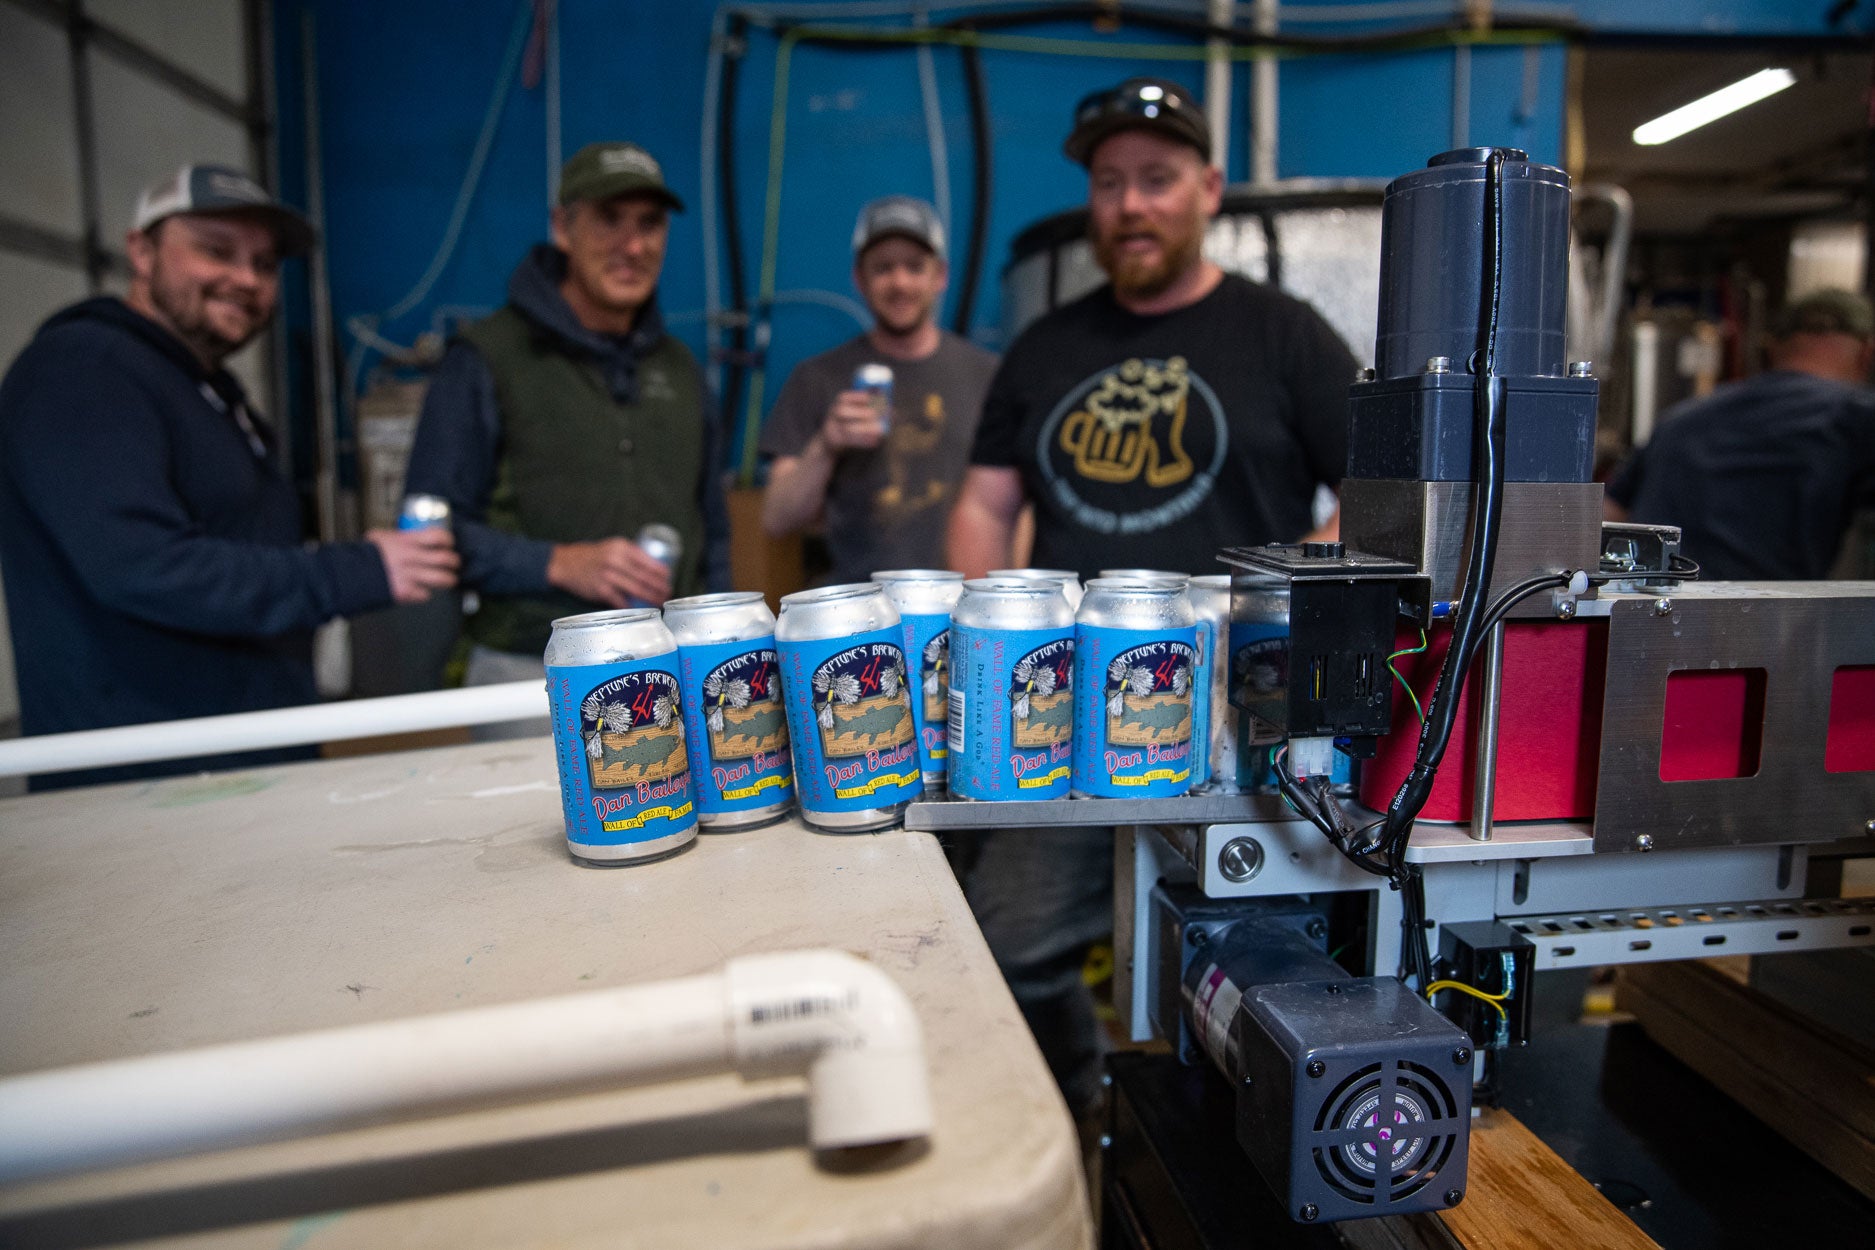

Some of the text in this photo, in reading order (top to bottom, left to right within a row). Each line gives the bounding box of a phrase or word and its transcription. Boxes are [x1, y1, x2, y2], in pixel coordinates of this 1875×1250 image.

[817, 646, 867, 678] NEPTUNE'S
[1021, 640, 1065, 669] NEPTUNE'S
[1092, 638, 1101, 672] WALL
[1115, 642, 1167, 665] NEPTUNE'S
[709, 652, 758, 682] NEPTUNE'S
[793, 652, 804, 686] WALL
[587, 674, 640, 706] NEPTUNE'S
[976, 663, 985, 696] DRINK
[1091, 675, 1099, 692] OF
[798, 690, 808, 707] OF
[976, 701, 984, 725] LIKE
[990, 640, 1004, 792] WALL OF FAME RED ALE
[1090, 695, 1099, 728] FAME
[1421, 720, 1430, 738] 300V
[561, 678, 588, 835] WALL OF FAME RED ALE
[1010, 753, 1047, 779] Dan
[1104, 751, 1143, 774] Dan
[712, 763, 751, 790] Dan
[824, 761, 863, 789] Dan
[873, 775, 896, 787] RED ALE
[903, 771, 918, 785] FAME
[1019, 779, 1039, 788] WALL
[1112, 776, 1144, 785] WALL OF
[1150, 770, 1171, 780] RED ALE
[723, 788, 754, 799] WALL OF
[836, 787, 868, 797] WALL OF
[592, 793, 633, 821] Dan
[643, 807, 667, 821] RED ALE
[674, 804, 691, 818] FAME
[604, 818, 637, 830] WALL OF
